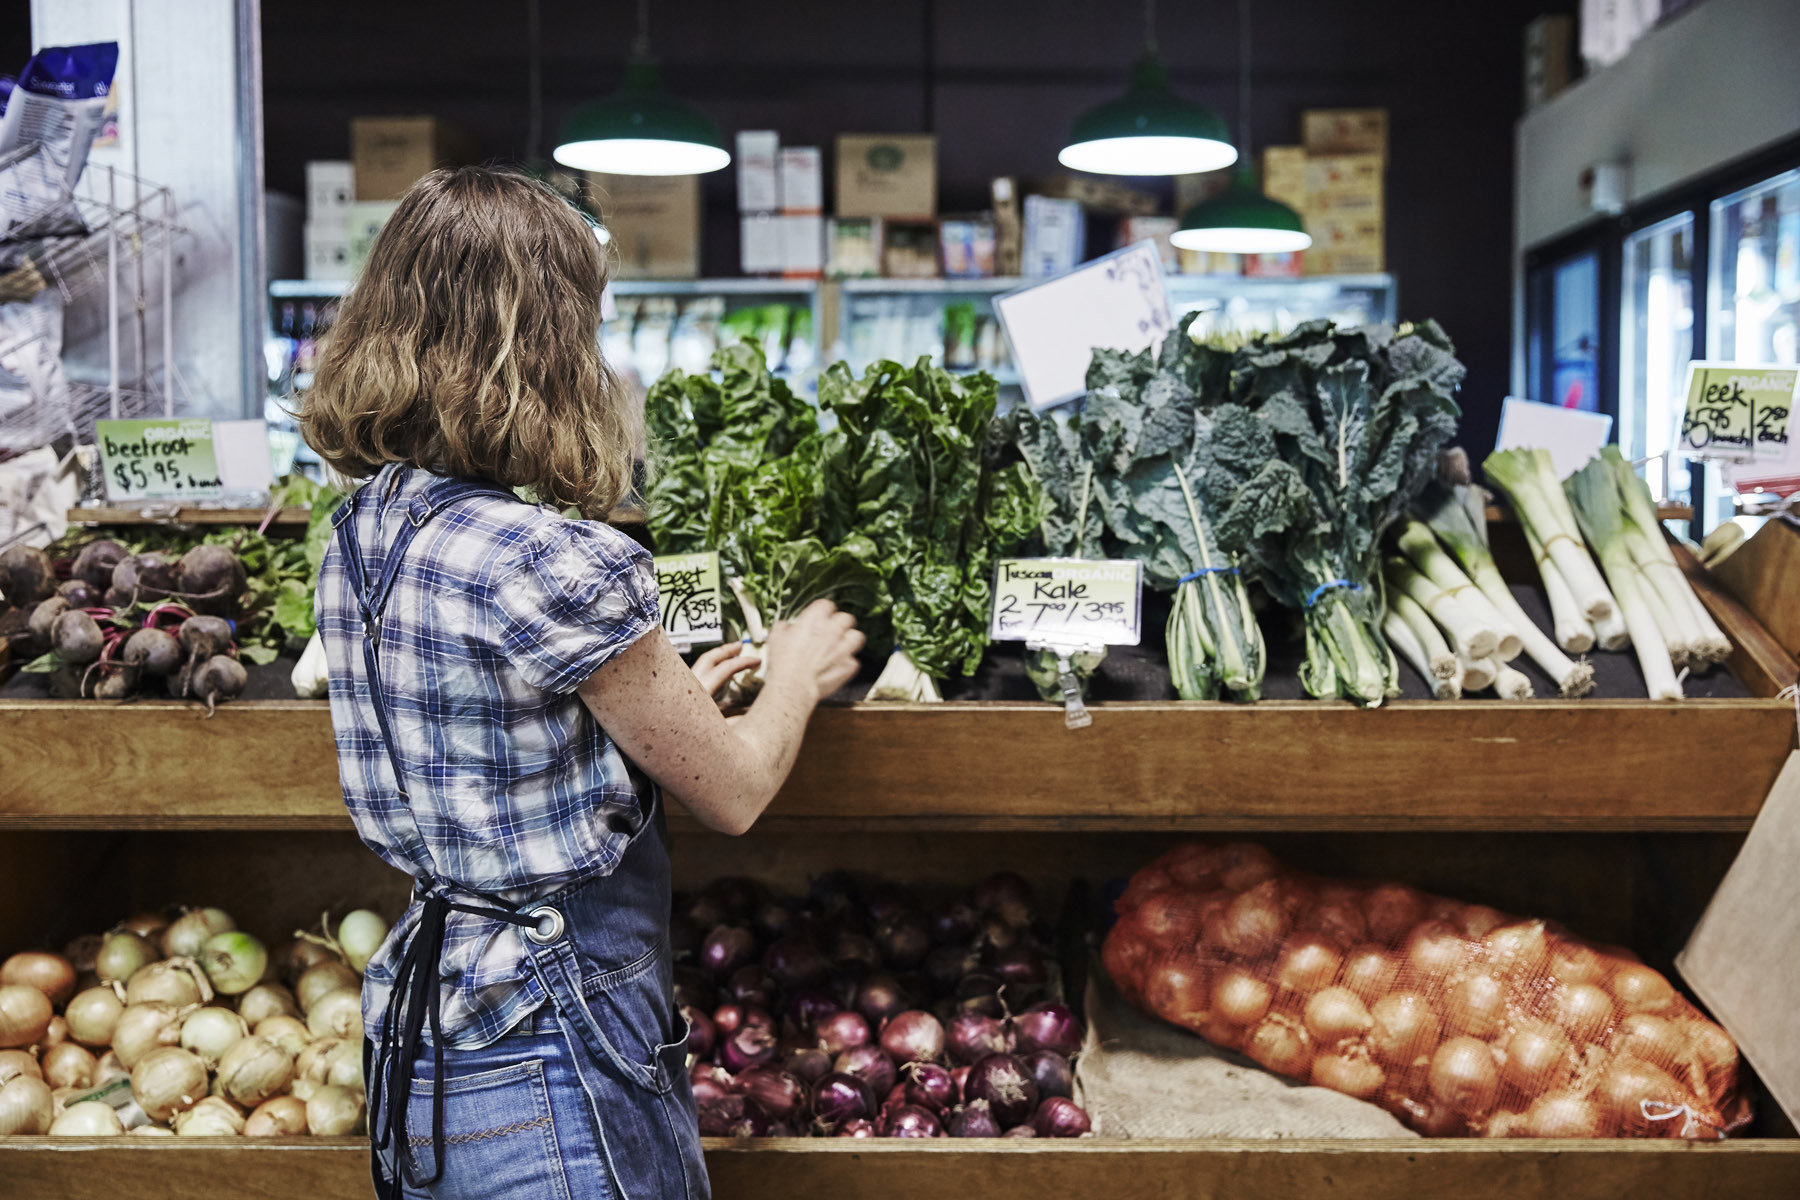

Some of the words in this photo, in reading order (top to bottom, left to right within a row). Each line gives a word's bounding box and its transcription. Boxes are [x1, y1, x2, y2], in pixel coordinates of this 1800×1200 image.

[1699, 370, 1748, 407] leek
[104, 435, 195, 458] beetroot
[1000, 563, 1053, 582] Tuscan
[1053, 567, 1133, 582] ORGANIC
[1034, 580, 1089, 599] Kale
[1000, 595, 1021, 613] 2
